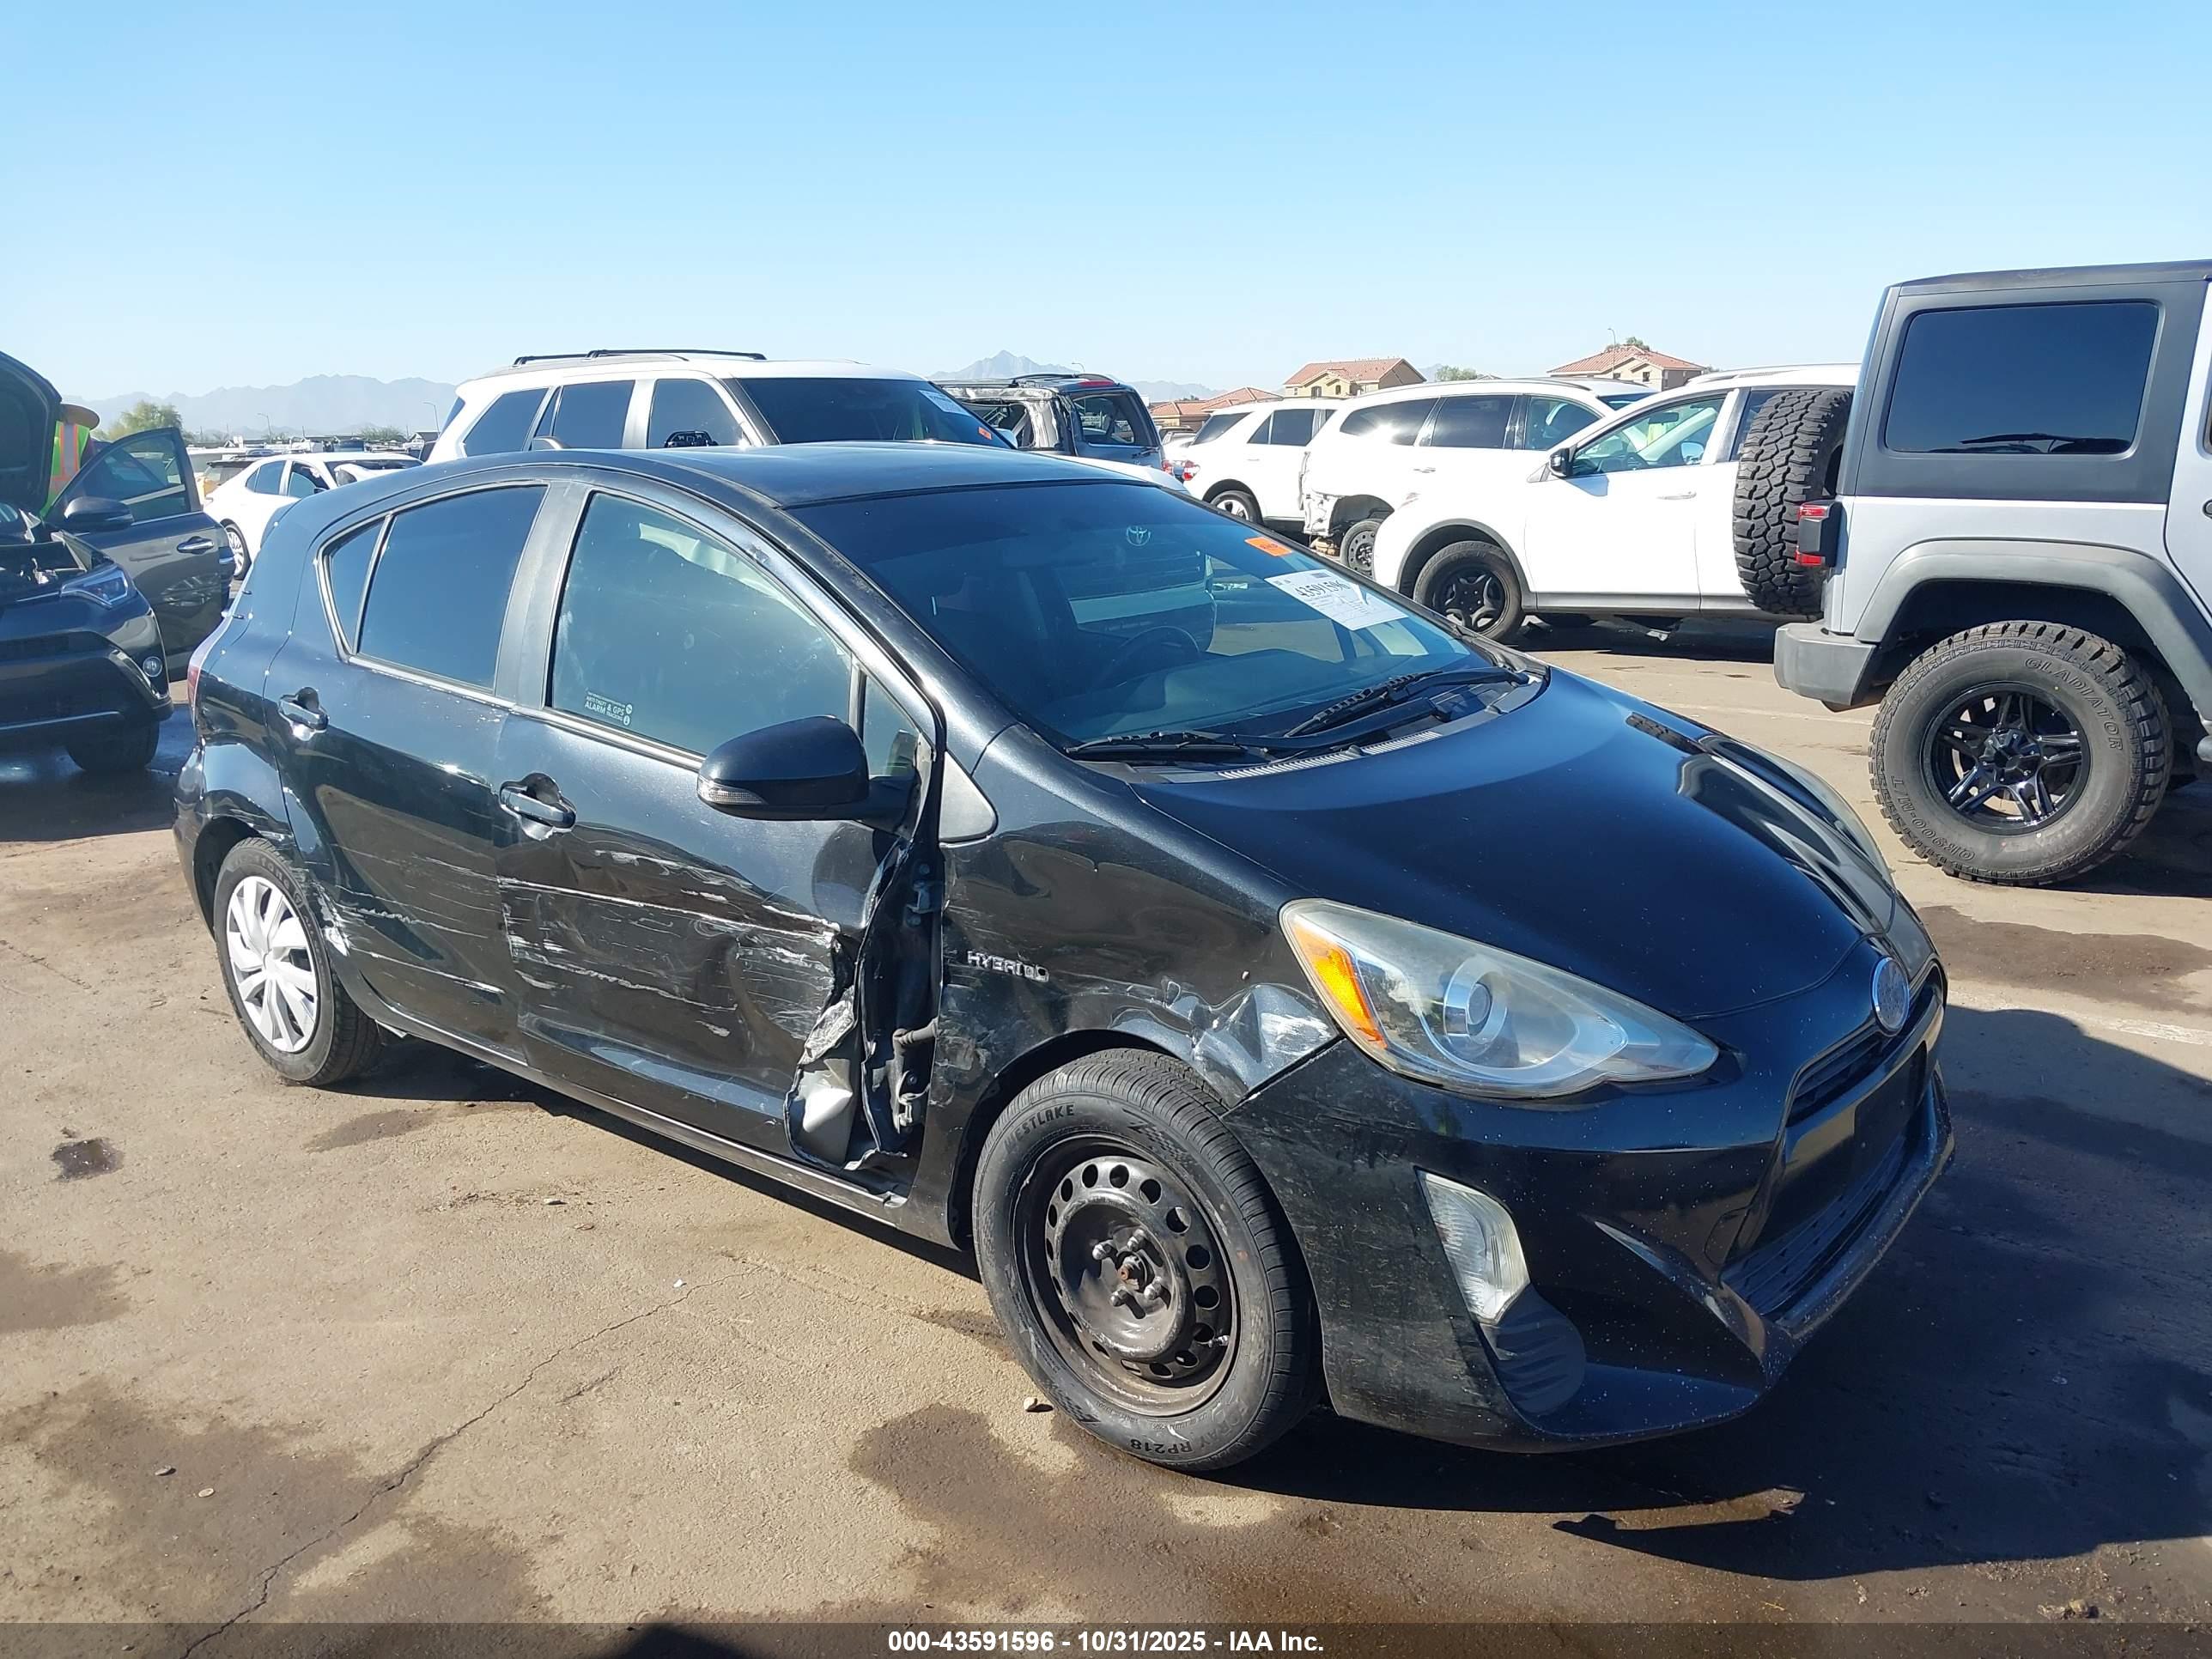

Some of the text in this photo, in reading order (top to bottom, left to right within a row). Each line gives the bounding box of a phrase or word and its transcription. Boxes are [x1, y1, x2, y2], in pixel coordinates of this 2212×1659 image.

[1295, 580, 1351, 598] 43591596
[584, 701, 606, 714] ALARM
[612, 706, 625, 716] GPS
[2025, 658, 2123, 750] GLADIATOR
[1003, 1104, 1074, 1155] WESTLAKE
[1130, 1438, 1194, 1455] RP218
